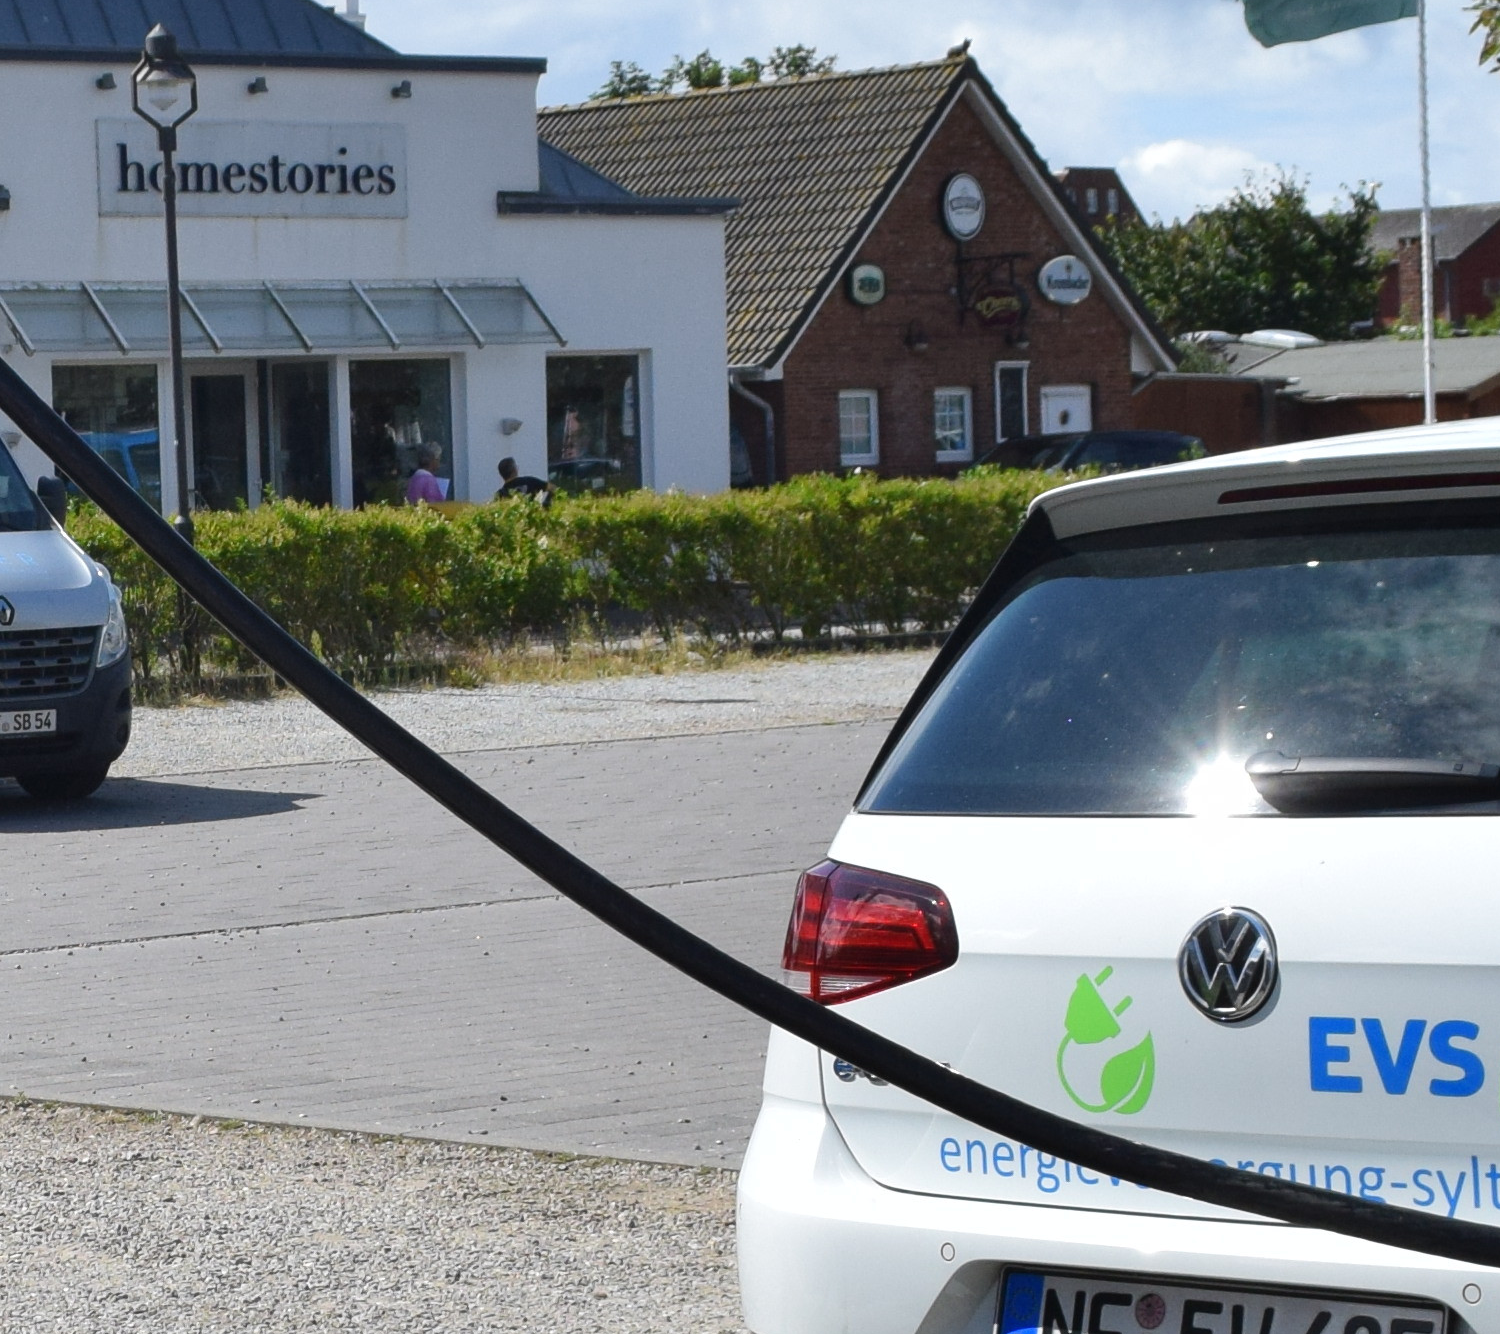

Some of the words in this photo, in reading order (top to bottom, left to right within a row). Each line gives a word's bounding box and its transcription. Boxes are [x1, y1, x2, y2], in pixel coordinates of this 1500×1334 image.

[116, 142, 397, 195] homestories
[13, 713, 32, 731] SB
[34, 712, 52, 730] 54
[1308, 1014, 1486, 1097] EVS
